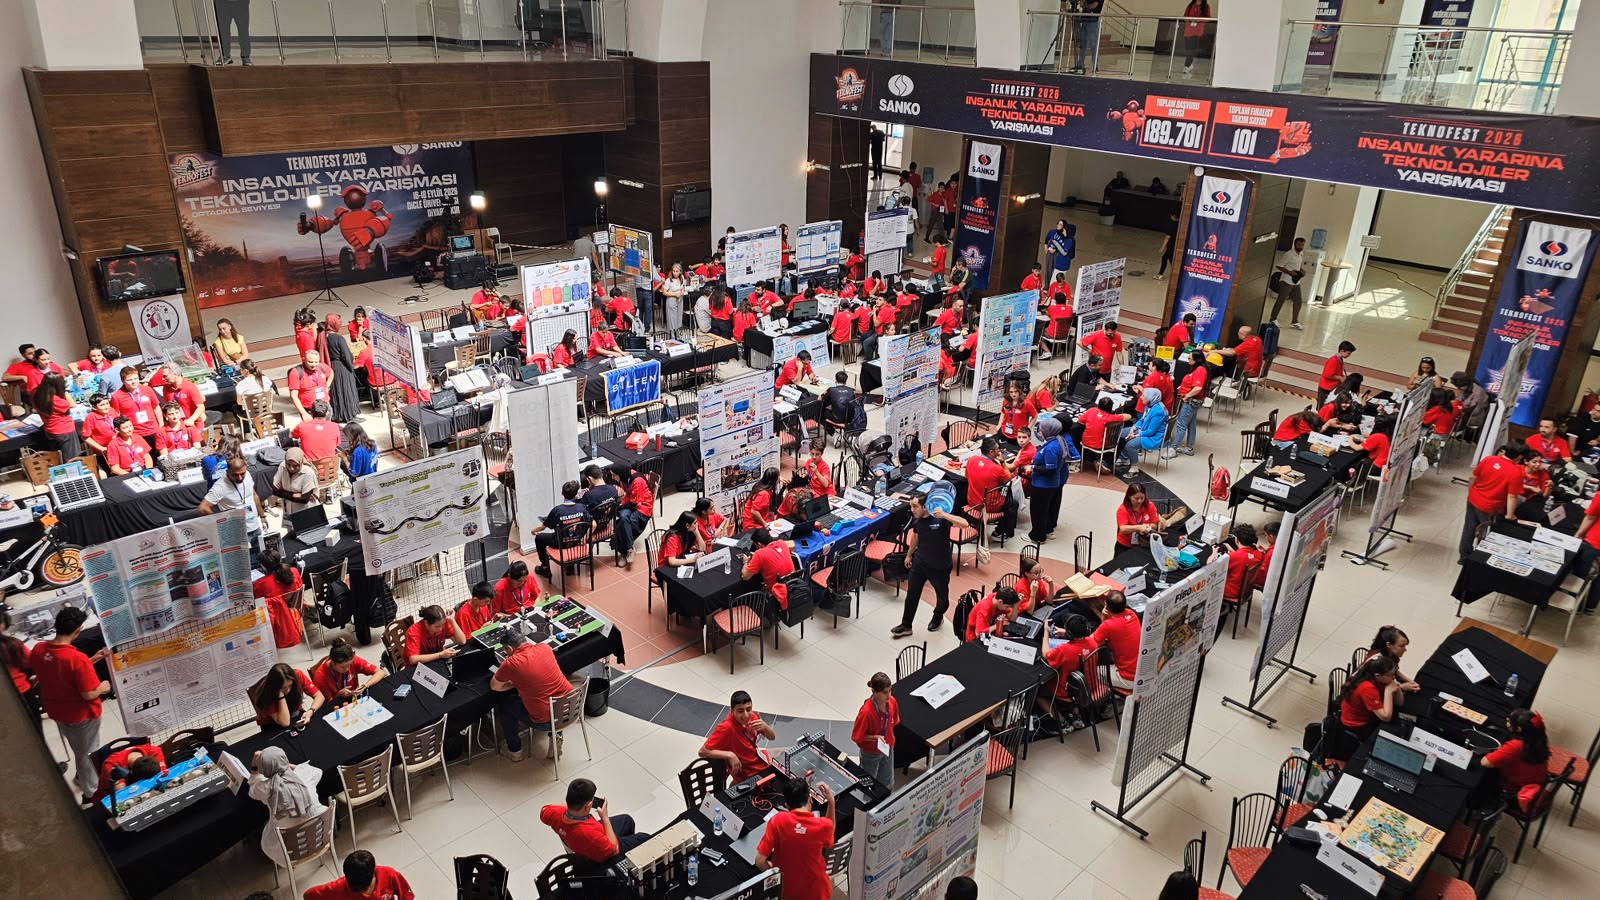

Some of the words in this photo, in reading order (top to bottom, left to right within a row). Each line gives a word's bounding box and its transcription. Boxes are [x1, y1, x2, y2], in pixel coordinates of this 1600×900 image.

[990, 83, 1035, 97] TEKNOFEST
[1038, 87, 1060, 100] 2026
[879, 98, 921, 116] SANKO
[1020, 101, 1085, 117] YARARINA
[1156, 98, 1176, 108] TOPLAM
[1229, 105, 1250, 115] TOPLAM
[990, 120, 1054, 136] YARIŞMASI
[1144, 118, 1203, 148] 189.701
[1402, 122, 1480, 142] TEKNOFEST
[1484, 130, 1523, 147] 2026
[1231, 128, 1258, 155] 101
[286, 154, 340, 171] TEKNOFEST
[342, 152, 368, 166] 2026
[1452, 146, 1565, 170] YARARINA
[172, 167, 214, 187] TEKNOFEST
[326, 164, 426, 183] YARARINA
[972, 165, 996, 176] SANKO
[358, 174, 458, 193] YARIŞMASI
[1396, 168, 1506, 193] YARIŞMASI
[1202, 204, 1235, 216] SANKO
[1187, 248, 1216, 260] TEKNOFEST
[1526, 256, 1574, 271] SANKO
[1500, 308, 1542, 322] TEKNOFEST
